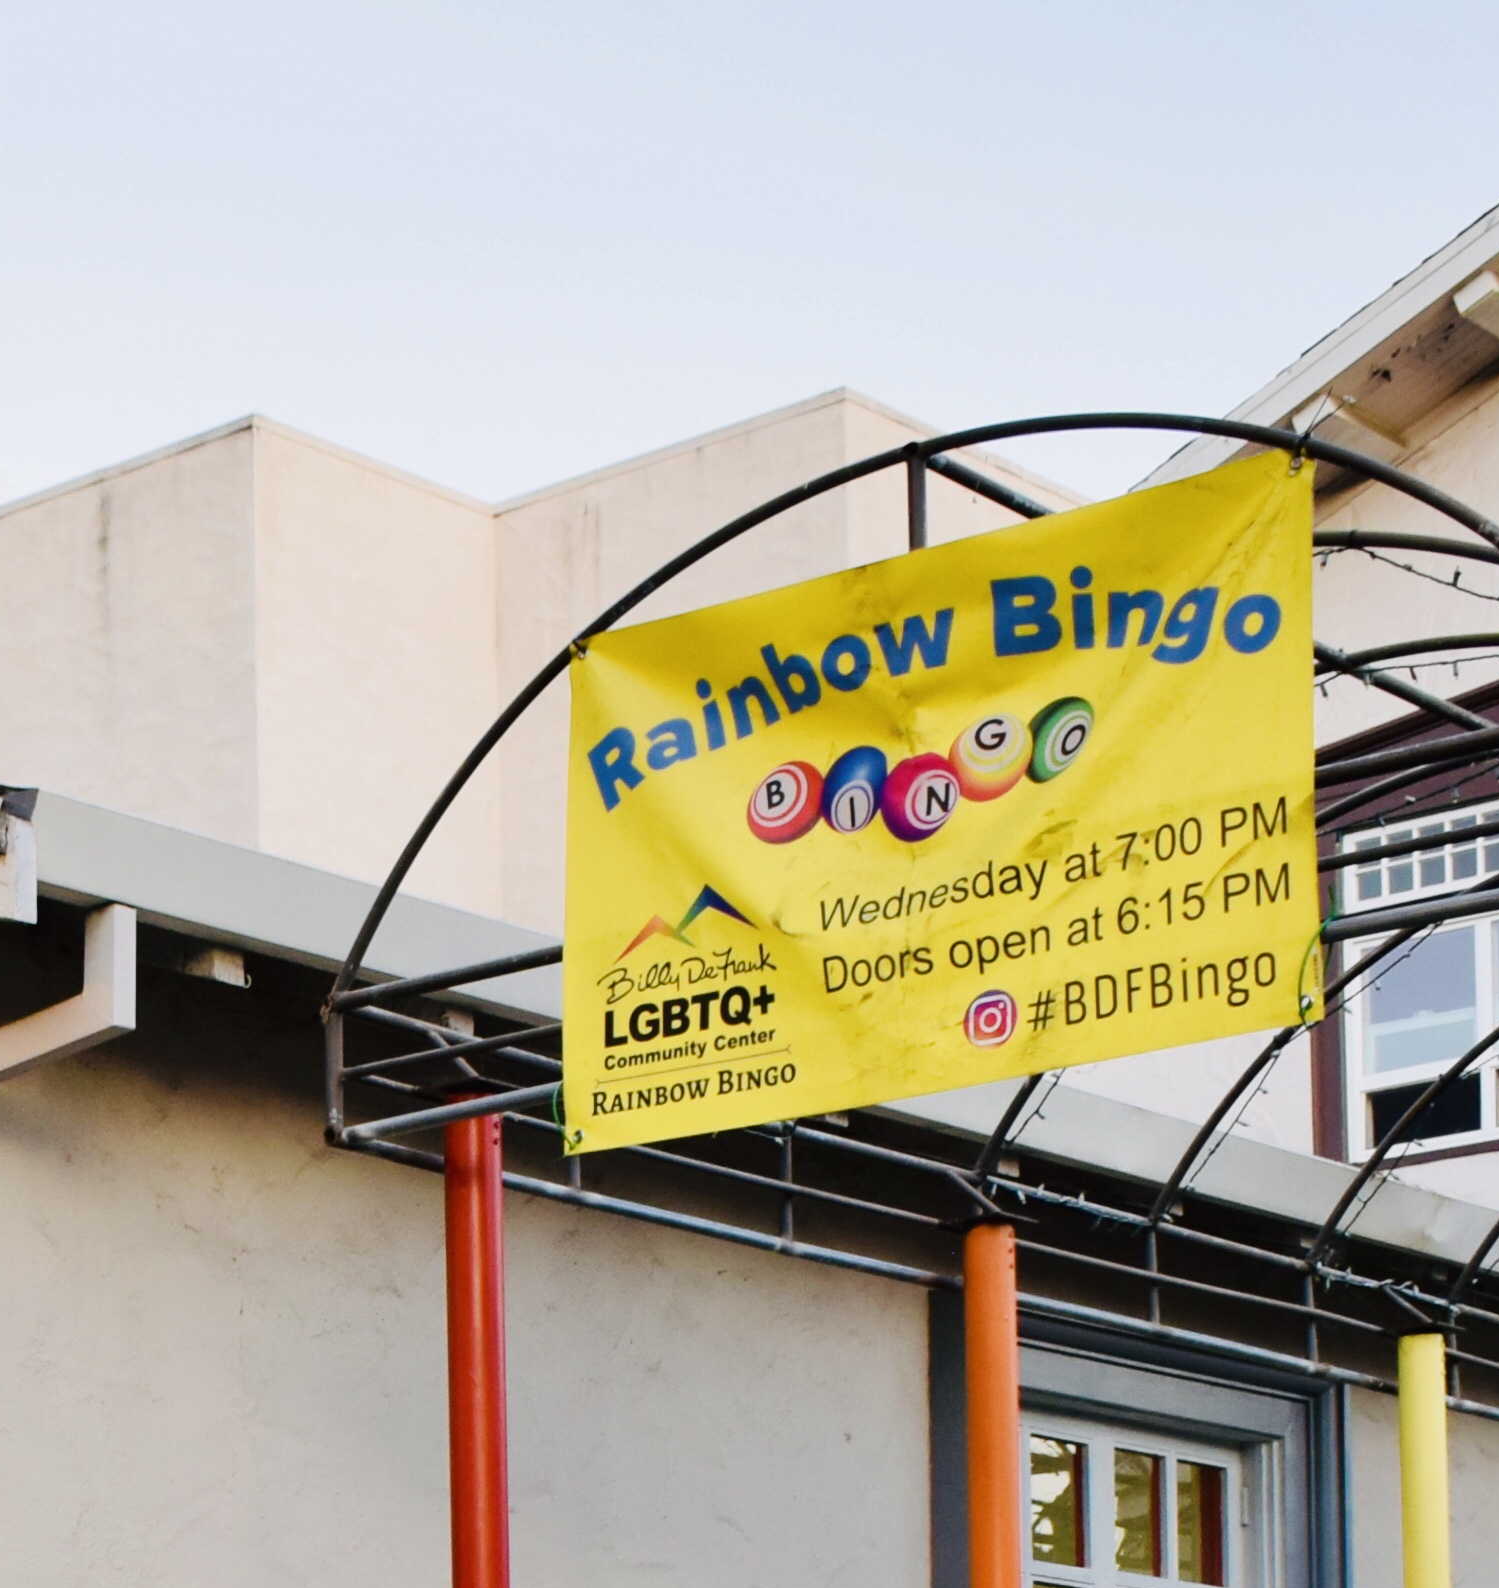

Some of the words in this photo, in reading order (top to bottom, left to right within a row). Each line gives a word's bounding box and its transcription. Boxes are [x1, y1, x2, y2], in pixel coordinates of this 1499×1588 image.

[587, 607, 954, 812] Rainbow
[990, 566, 1282, 664] Bingo
[818, 861, 1048, 931] Wednesday
[1064, 842, 1101, 882] at
[1115, 817, 1202, 871] 7:00
[1219, 796, 1288, 848] PM
[822, 946, 934, 993] Doors
[948, 924, 1051, 974] open
[1067, 907, 1103, 946] at
[1116, 881, 1205, 934] 6:15
[1222, 862, 1290, 914] PM
[597, 961, 680, 1005] Billy
[681, 943, 777, 984] DeFrank
[1027, 951, 1277, 1031] #BDFBingo
[604, 984, 776, 1048] LGBTQ+
[604, 1041, 707, 1071] Community
[714, 1028, 776, 1051] Center
[591, 1078, 711, 1117] RAINBOW
[716, 1063, 797, 1096] BINGO
